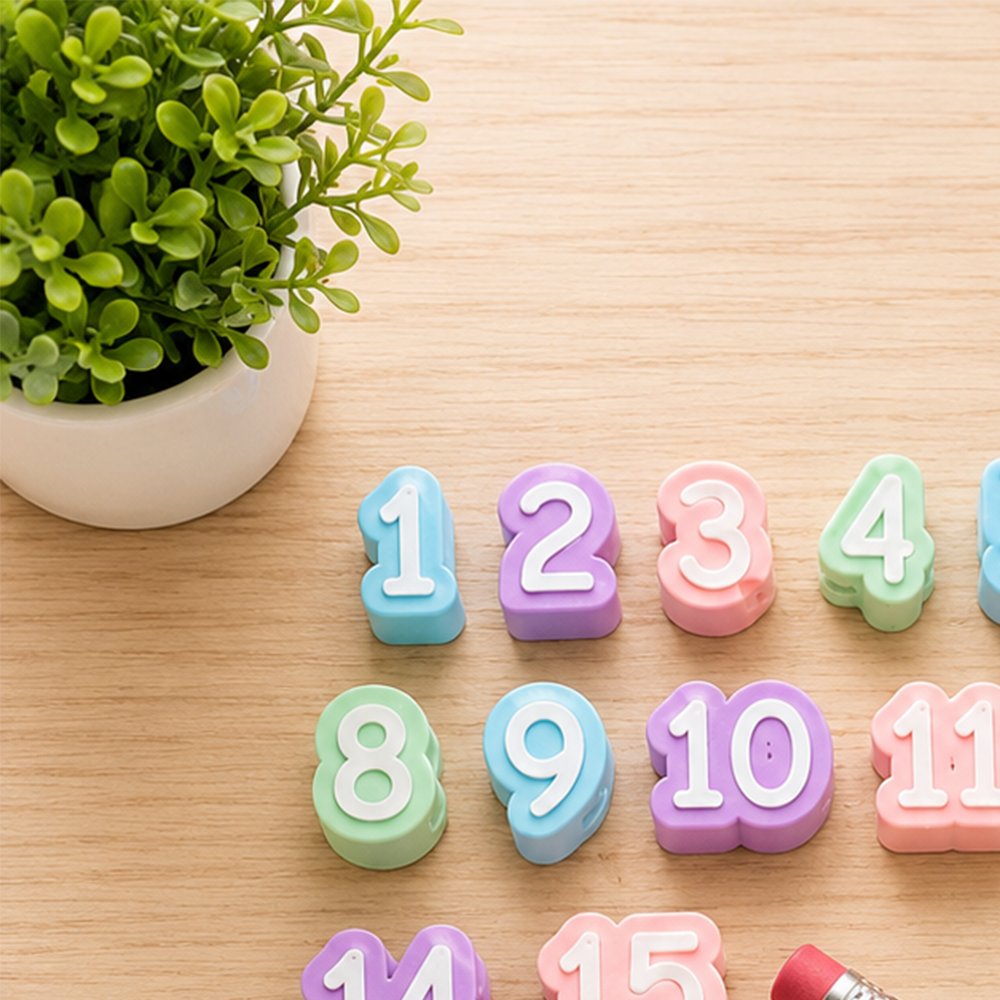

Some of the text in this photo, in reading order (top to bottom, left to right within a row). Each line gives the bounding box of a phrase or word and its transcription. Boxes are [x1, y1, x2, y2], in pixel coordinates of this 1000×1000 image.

[380, 484, 436, 596] 1
[519, 481, 595, 592] 2
[678, 479, 752, 590] 3
[840, 473, 915, 584] 4
[333, 703, 413, 821] 8
[505, 701, 585, 817] 9
[669, 698, 812, 810] 10
